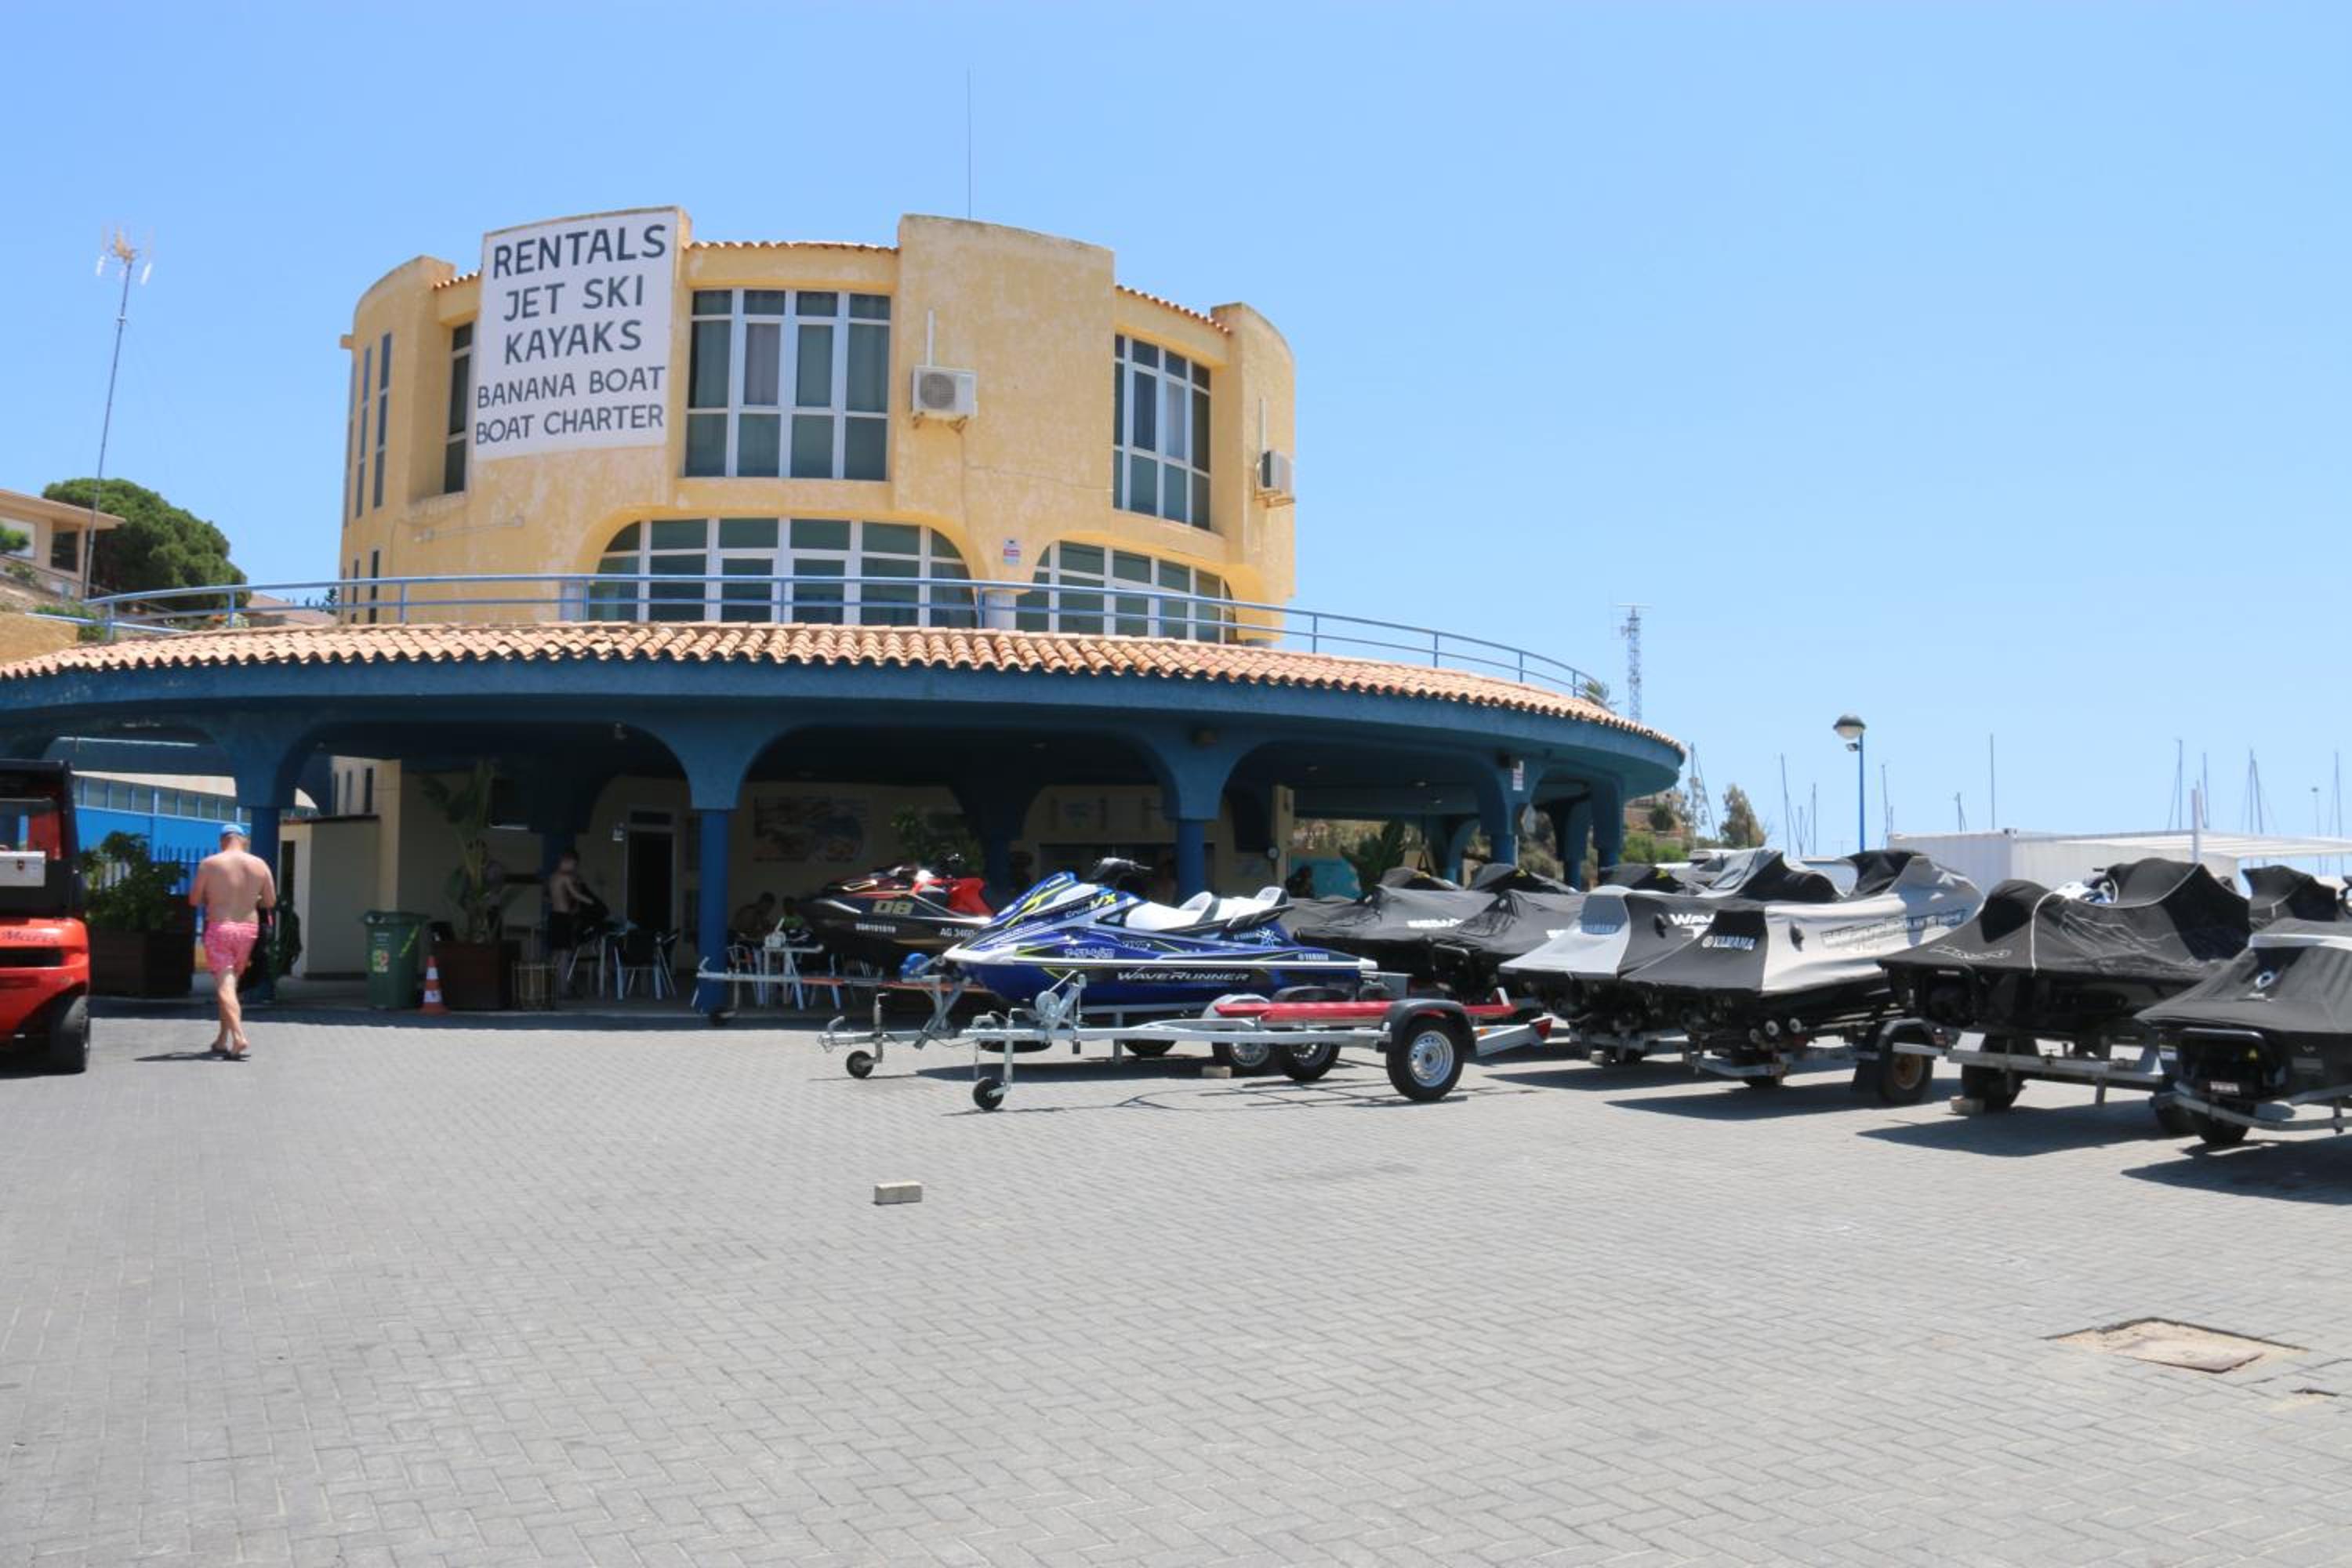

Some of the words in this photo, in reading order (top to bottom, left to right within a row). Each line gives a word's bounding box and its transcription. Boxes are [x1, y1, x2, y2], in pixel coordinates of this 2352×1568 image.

[494, 224, 666, 278] RENTALS
[504, 283, 564, 321] JET
[583, 274, 643, 309] SKI
[505, 319, 641, 365] KAYAKS
[477, 372, 575, 408] BANANA
[589, 366, 666, 394] BOAT
[476, 414, 534, 445] BOAT
[543, 404, 664, 435] CHARTER
[1712, 936, 1755, 950] YAMAHA
